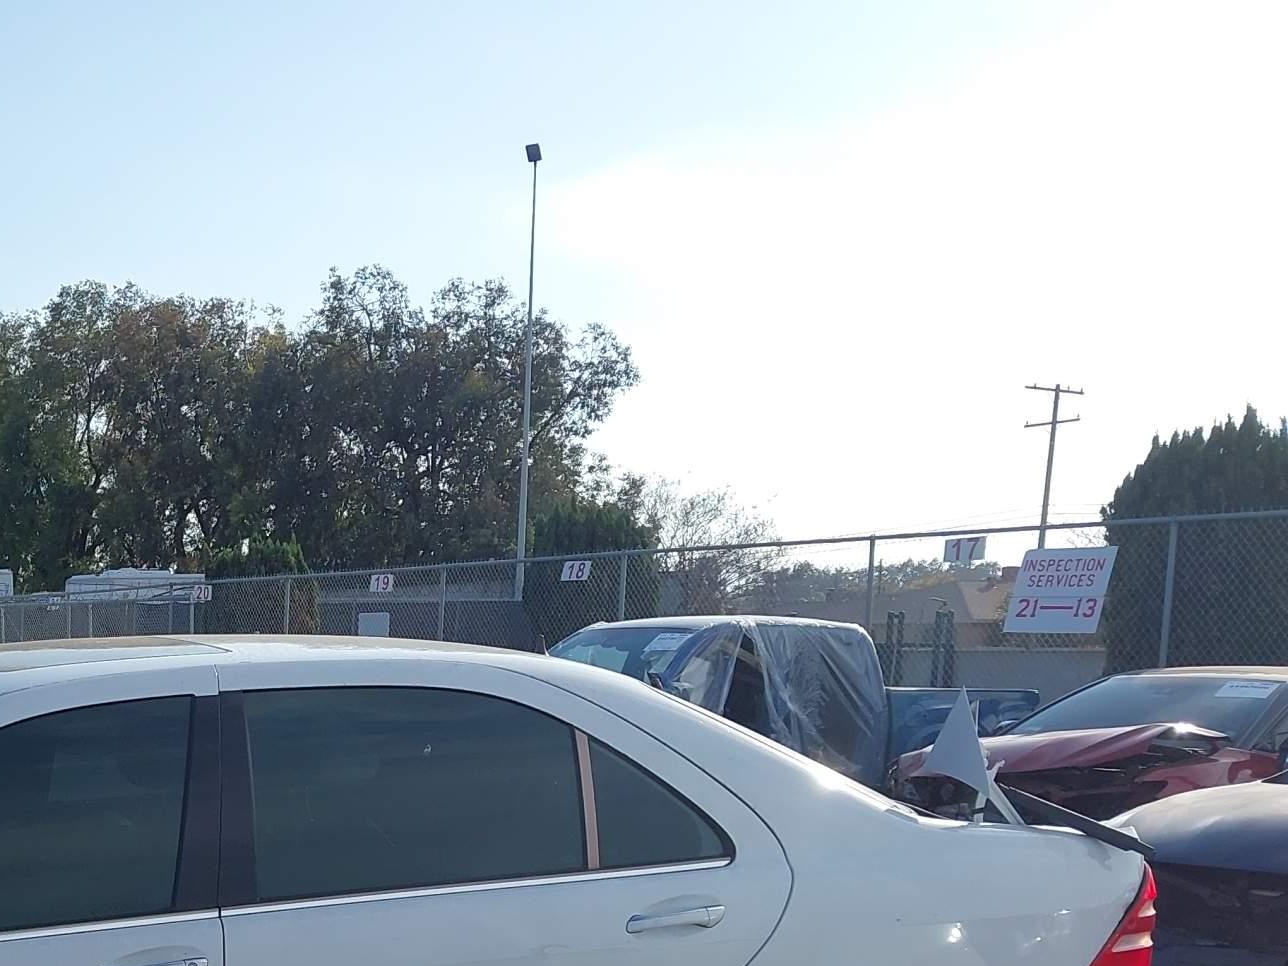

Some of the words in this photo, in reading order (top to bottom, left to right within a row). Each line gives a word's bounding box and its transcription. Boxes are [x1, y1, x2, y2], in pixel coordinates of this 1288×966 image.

[952, 537, 981, 560] 17
[567, 562, 586, 580] 18
[1023, 558, 1107, 573] INSPECTION
[373, 575, 390, 591] 19
[1027, 574, 1096, 588] SERVICES
[195, 586, 210, 600] 20
